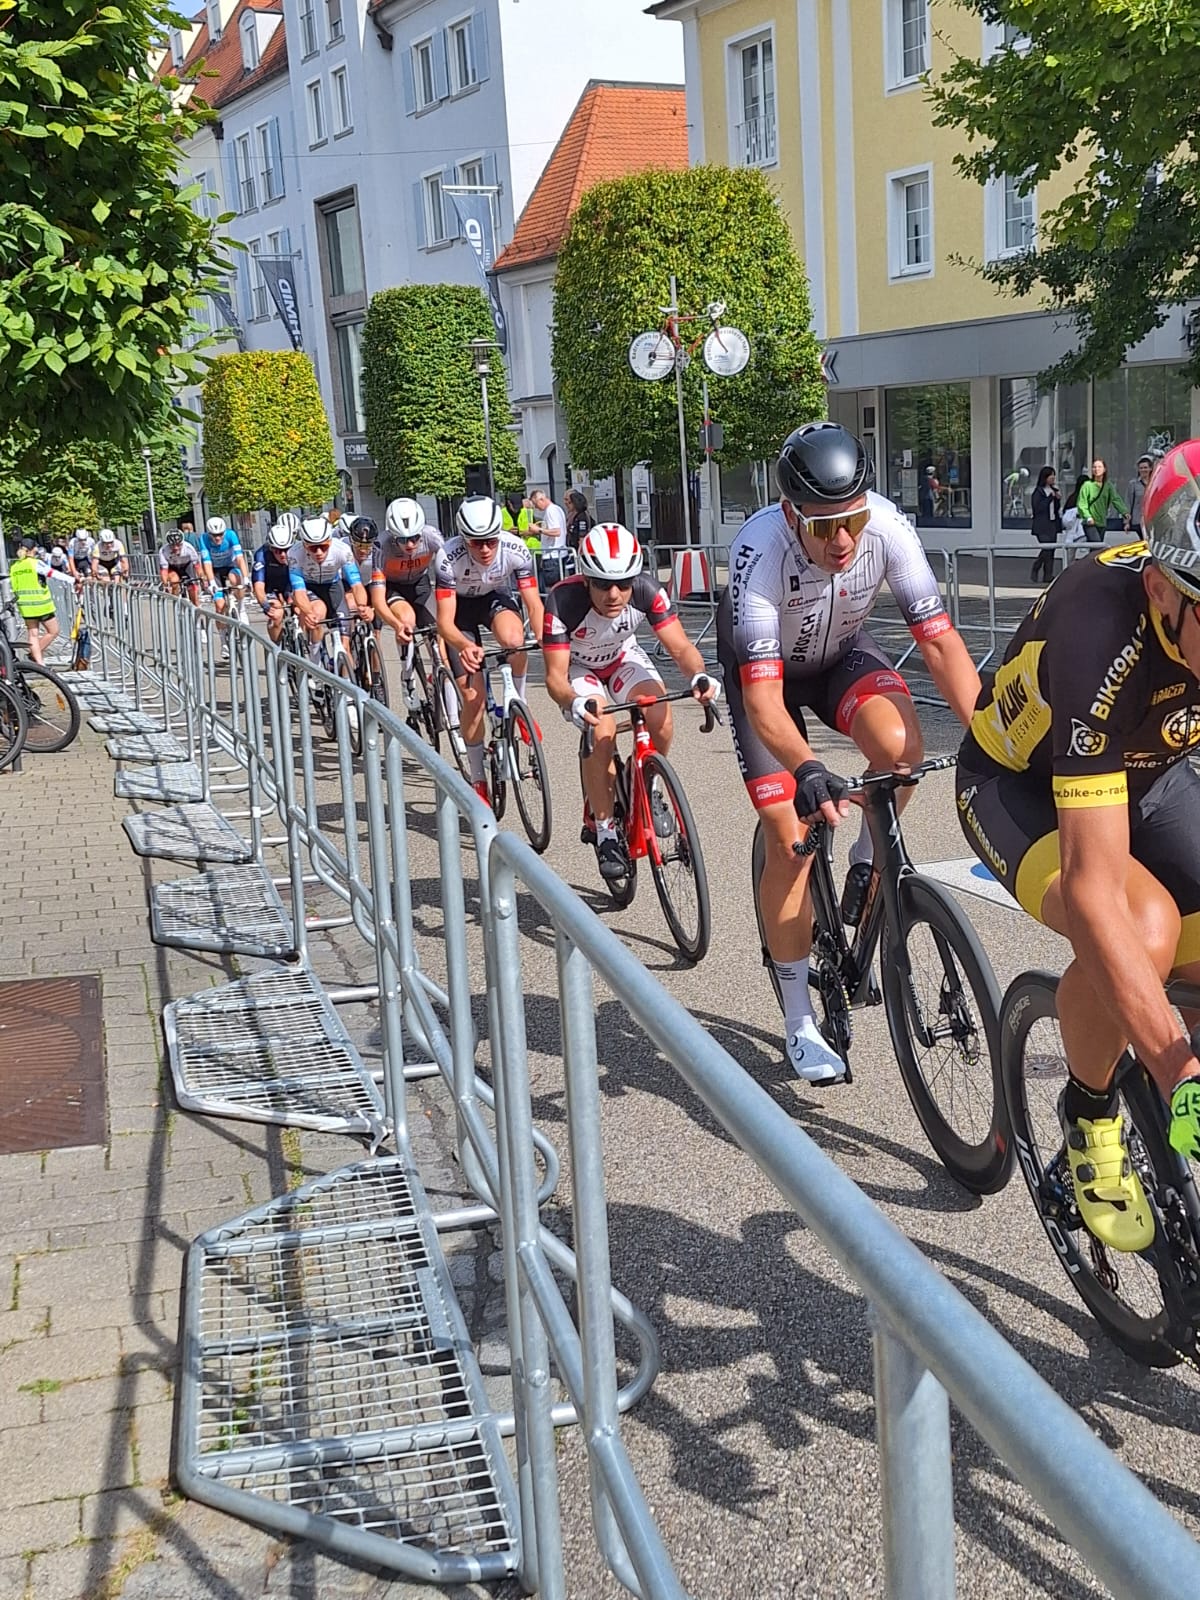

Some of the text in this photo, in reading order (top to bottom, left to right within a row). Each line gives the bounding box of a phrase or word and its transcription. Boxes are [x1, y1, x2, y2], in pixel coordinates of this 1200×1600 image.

[441, 547, 466, 572] BROSCH
[732, 544, 755, 626] BROSCH
[790, 613, 817, 663] BROSCH
